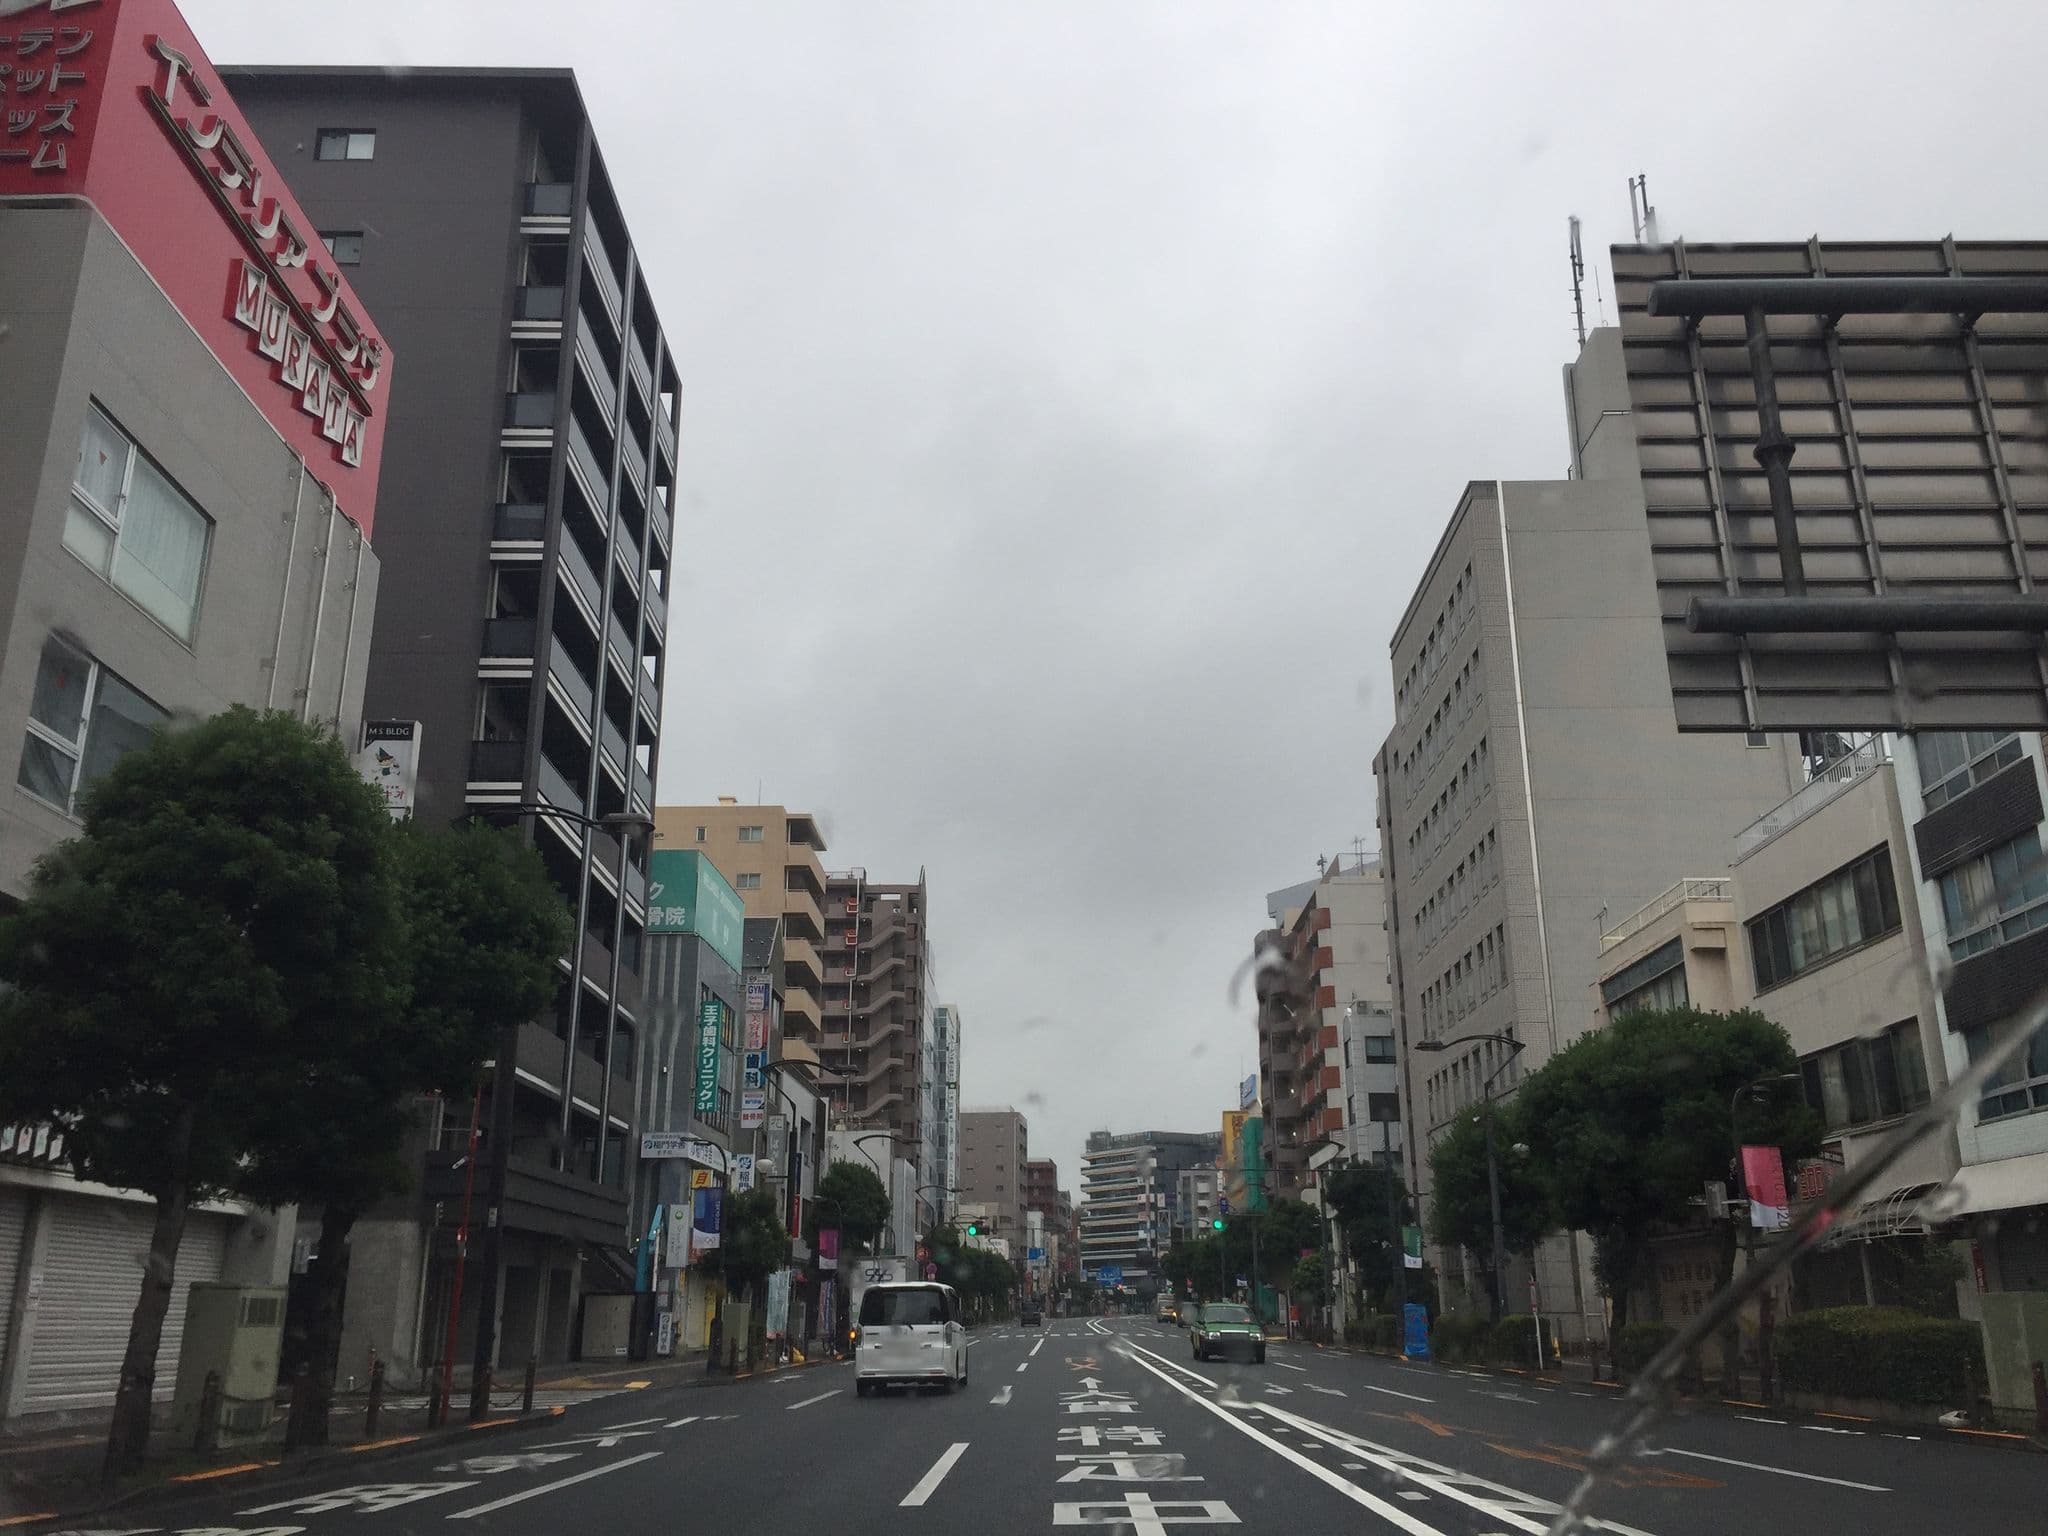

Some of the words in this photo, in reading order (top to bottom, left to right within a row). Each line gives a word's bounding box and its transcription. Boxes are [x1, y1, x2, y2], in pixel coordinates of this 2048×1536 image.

[146, 34, 384, 391] インテリアプラザ
[235, 262, 365, 466] MURATA
[386, 727, 410, 736] BLDG
[748, 985, 765, 994] GYM
[699, 1004, 719, 1101] 王子歯科クリニック
[745, 1053, 760, 1087] 歯科
[697, 1102, 714, 1111] 3F
